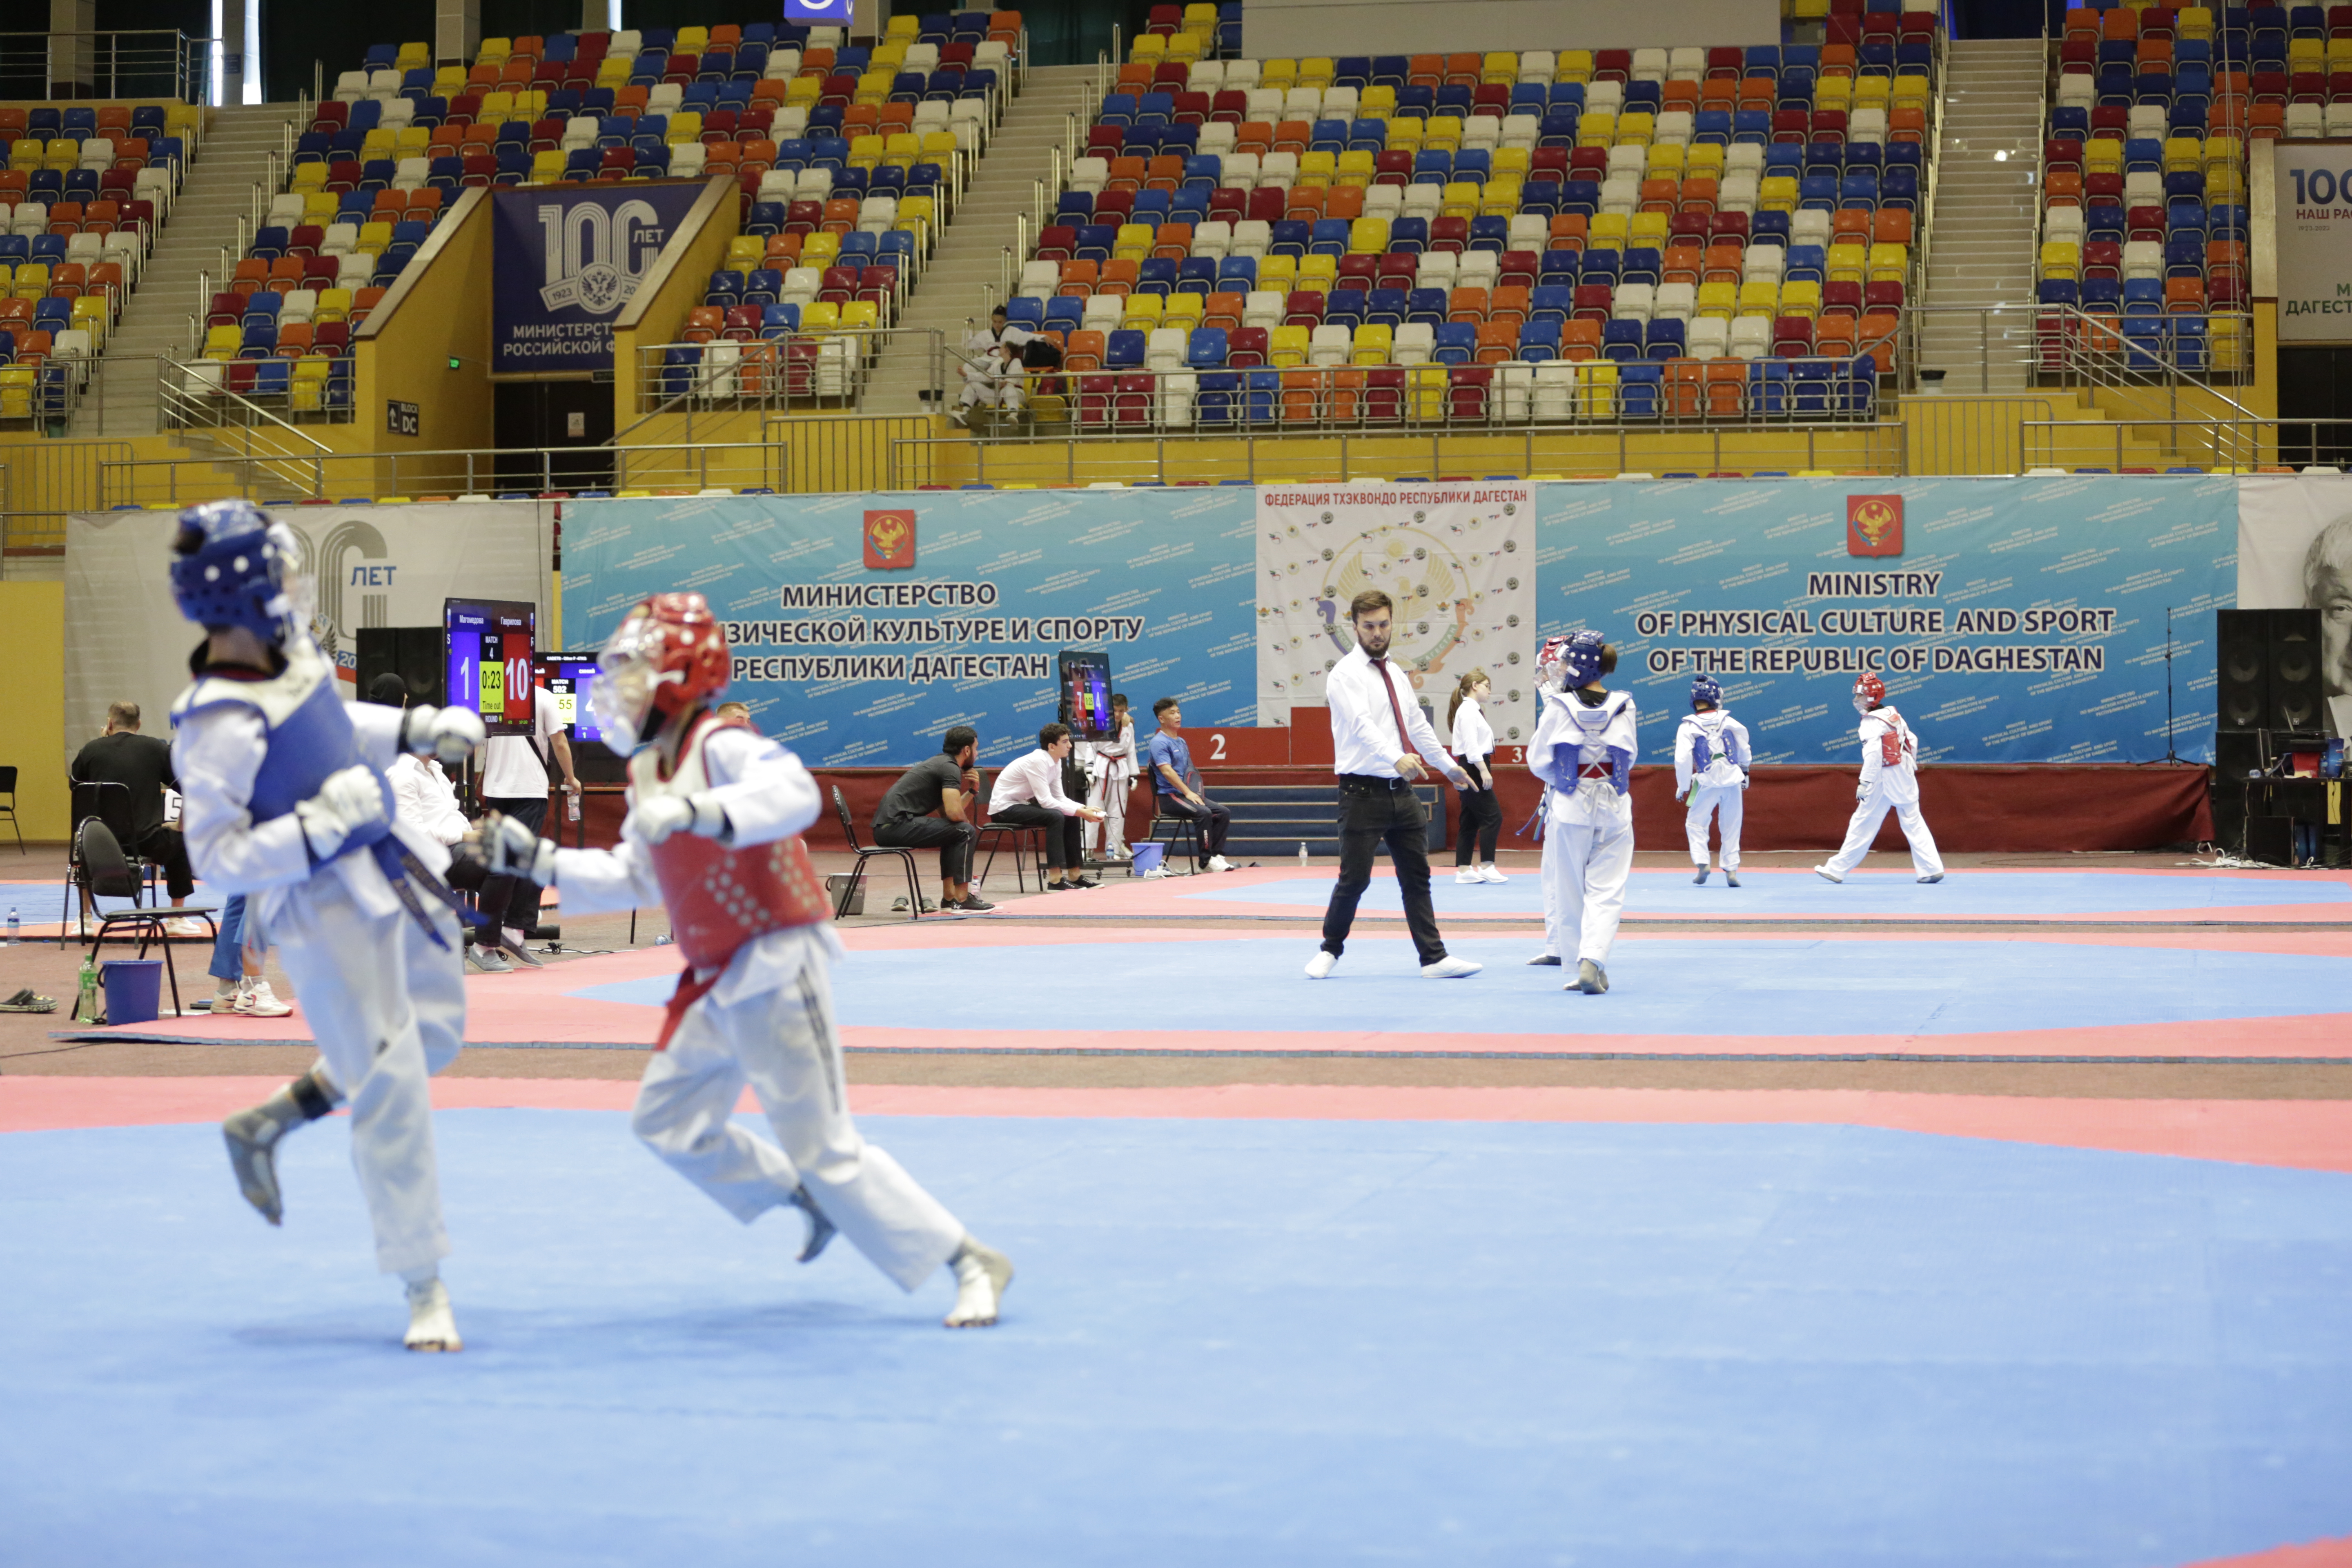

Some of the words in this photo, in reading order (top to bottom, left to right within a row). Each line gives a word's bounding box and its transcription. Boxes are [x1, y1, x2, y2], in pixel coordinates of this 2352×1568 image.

[2296, 209, 2329, 220] НАШ
[633, 229, 664, 243] ЛЕТ
[552, 288, 572, 300] 1923
[2337, 283, 2352, 296] М
[2286, 300, 2352, 316] ДАГЕСТ
[513, 322, 615, 339] МИНИСТЕРСТ
[503, 336, 601, 356] РОССИЙСКОЙ
[401, 403, 417, 414] BLOCK
[403, 416, 416, 434] DC
[1265, 493, 1330, 507] ФЕДЕРАЦИЯ
[1333, 492, 1396, 506] ТХЭКВОНДО
[1400, 491, 1470, 504] РЕСПУБЛИКИ
[1473, 490, 1527, 504] ДАГЕСТАН
[351, 566, 396, 586] ЛЕТ
[1809, 573, 1940, 595] MINISTRY
[783, 584, 996, 608] МИНИСТЕРСТВО
[459, 615, 484, 625] Магомедова
[501, 617, 521, 627] Гаврилова
[1638, 613, 1673, 635] OF
[1682, 612, 1813, 634] PHYSICAL
[1821, 611, 1942, 633] CULTURE
[1956, 611, 2016, 632] AND
[2025, 610, 2114, 632] SPORT
[874, 620, 1004, 641] КУЛЬТУРЕ
[1012, 620, 1028, 640] И
[1037, 619, 1143, 640] СПОРТУ
[1425, 627, 1457, 660] АГЕСТАН
[339, 653, 356, 668] 20
[490, 647, 494, 659] 4
[1649, 650, 1685, 672] OF
[1691, 650, 1743, 672] THE
[1752, 649, 1882, 671] REPUBLIC
[1891, 649, 1926, 670] OF
[1935, 648, 2102, 670] DAGHESTAN
[734, 657, 903, 679] РЕСПУБЛИКИ
[911, 656, 1047, 682] ДАГЕСТАН
[461, 657, 469, 700] 1
[482, 670, 501, 689] 0:23
[506, 658, 528, 701] 10
[552, 685, 567, 693] 502
[483, 701, 492, 710] Time
[1077, 692, 1082, 710] 7
[1096, 692, 1102, 710] 4
[1210, 734, 1226, 760] 2
[1512, 747, 1523, 763] 3
